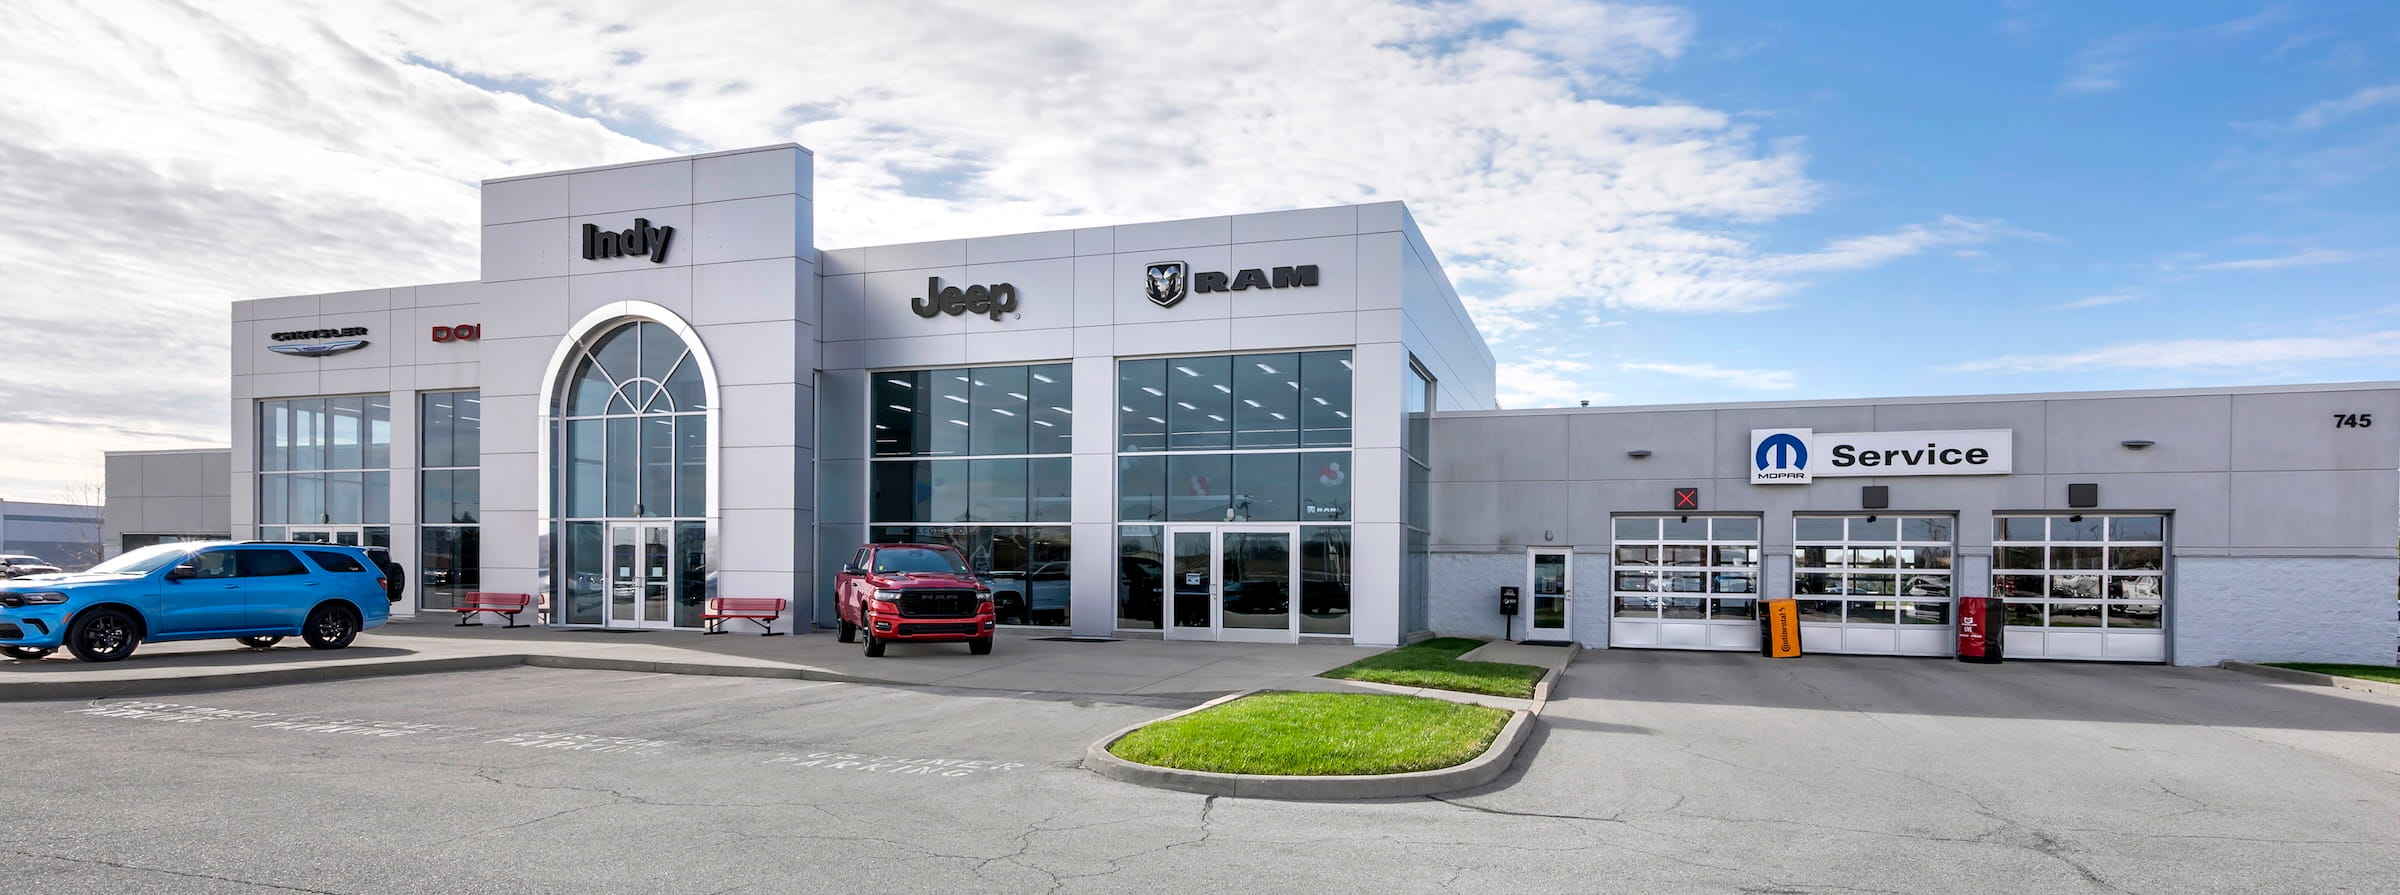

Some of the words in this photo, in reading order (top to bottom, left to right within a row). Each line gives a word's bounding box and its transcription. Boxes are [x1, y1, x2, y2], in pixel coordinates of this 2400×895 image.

[583, 218, 675, 263] Indy
[1194, 265, 1319, 293] RAM
[911, 276, 1018, 321] Jeep
[432, 324, 481, 342] DO
[2333, 414, 2372, 428] 745
[1832, 444, 1989, 467] Service
[760, 757, 976, 777] PARKING
[777, 752, 1025, 770] USTOMER
